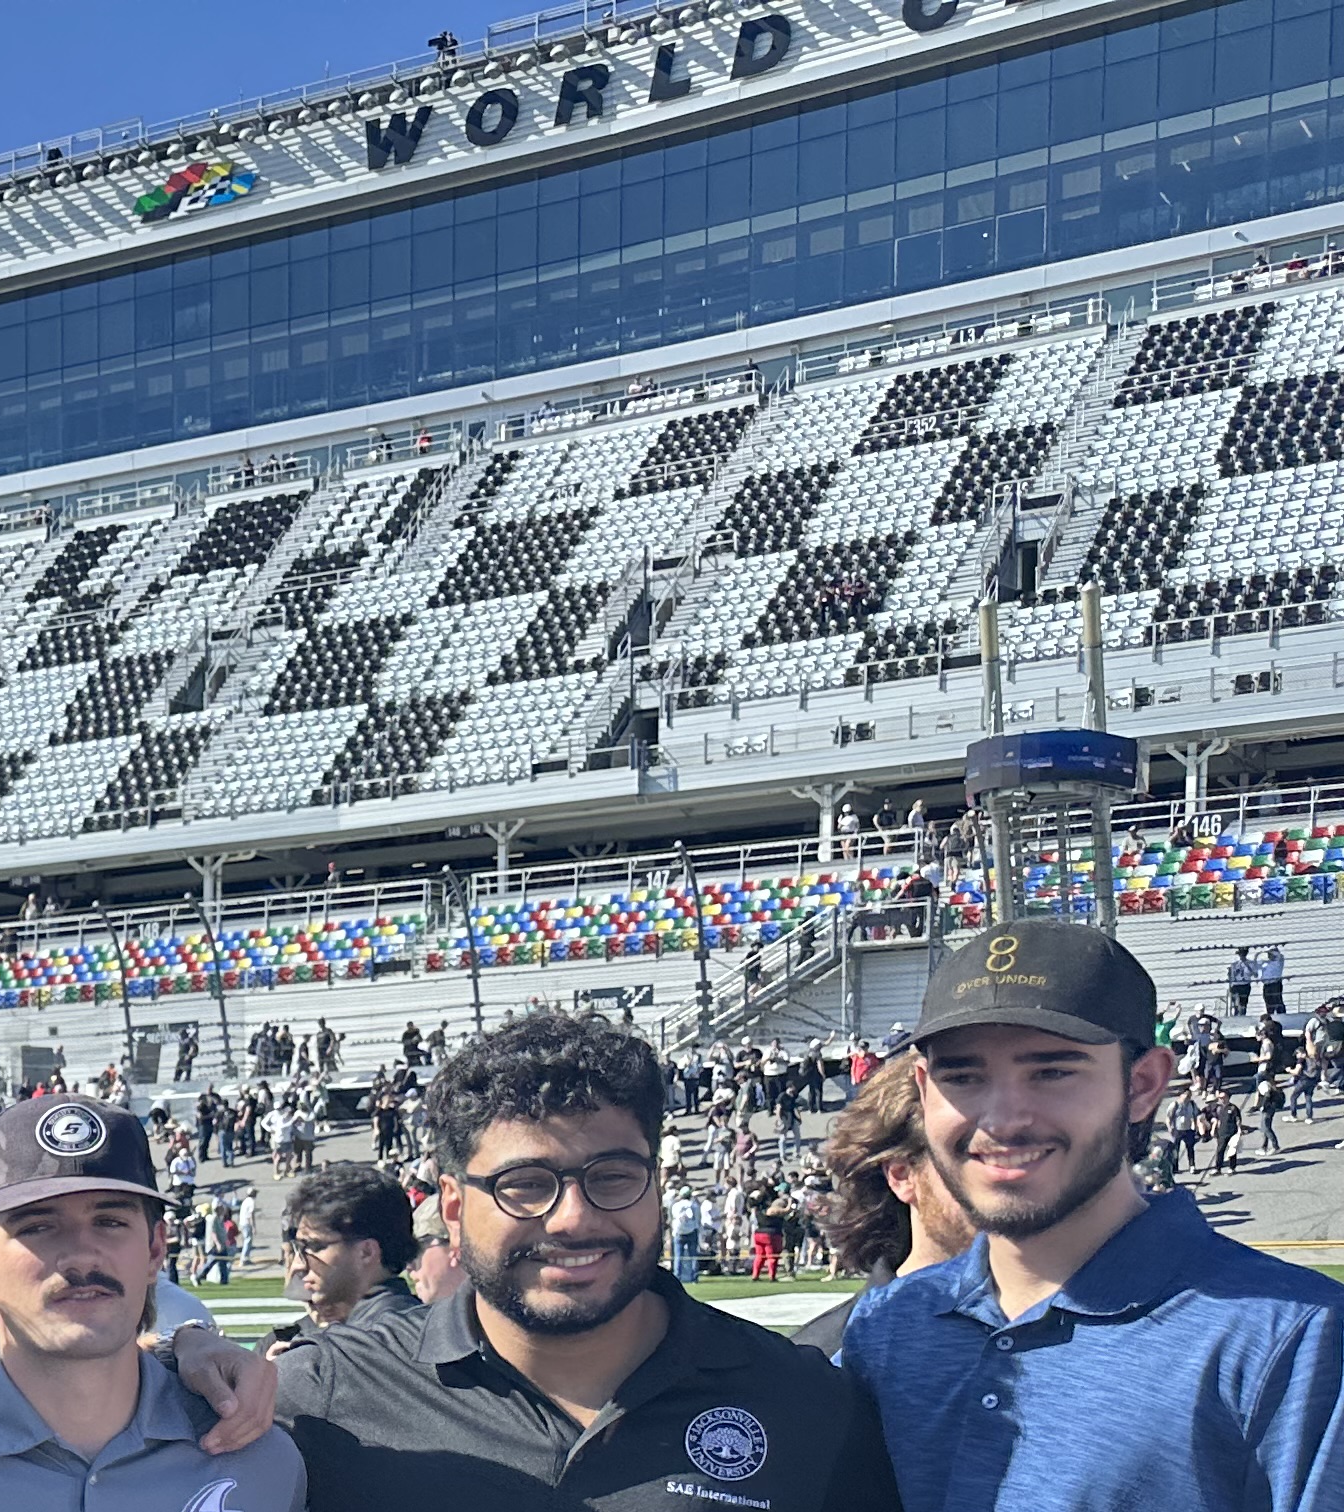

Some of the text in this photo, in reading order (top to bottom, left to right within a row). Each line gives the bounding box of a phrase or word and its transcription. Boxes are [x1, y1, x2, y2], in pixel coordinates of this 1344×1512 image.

[365, 14, 791, 170] WORLD
[1192, 814, 1222, 838] 146
[646, 869, 670, 890] 147
[138, 922, 160, 941] 148
[995, 974, 1047, 987] UNDER
[690, 1410, 763, 1445] JACKSONVILLE
[690, 1446, 758, 1478] UNIVERSITY
[666, 1481, 771, 1510] SAE International
